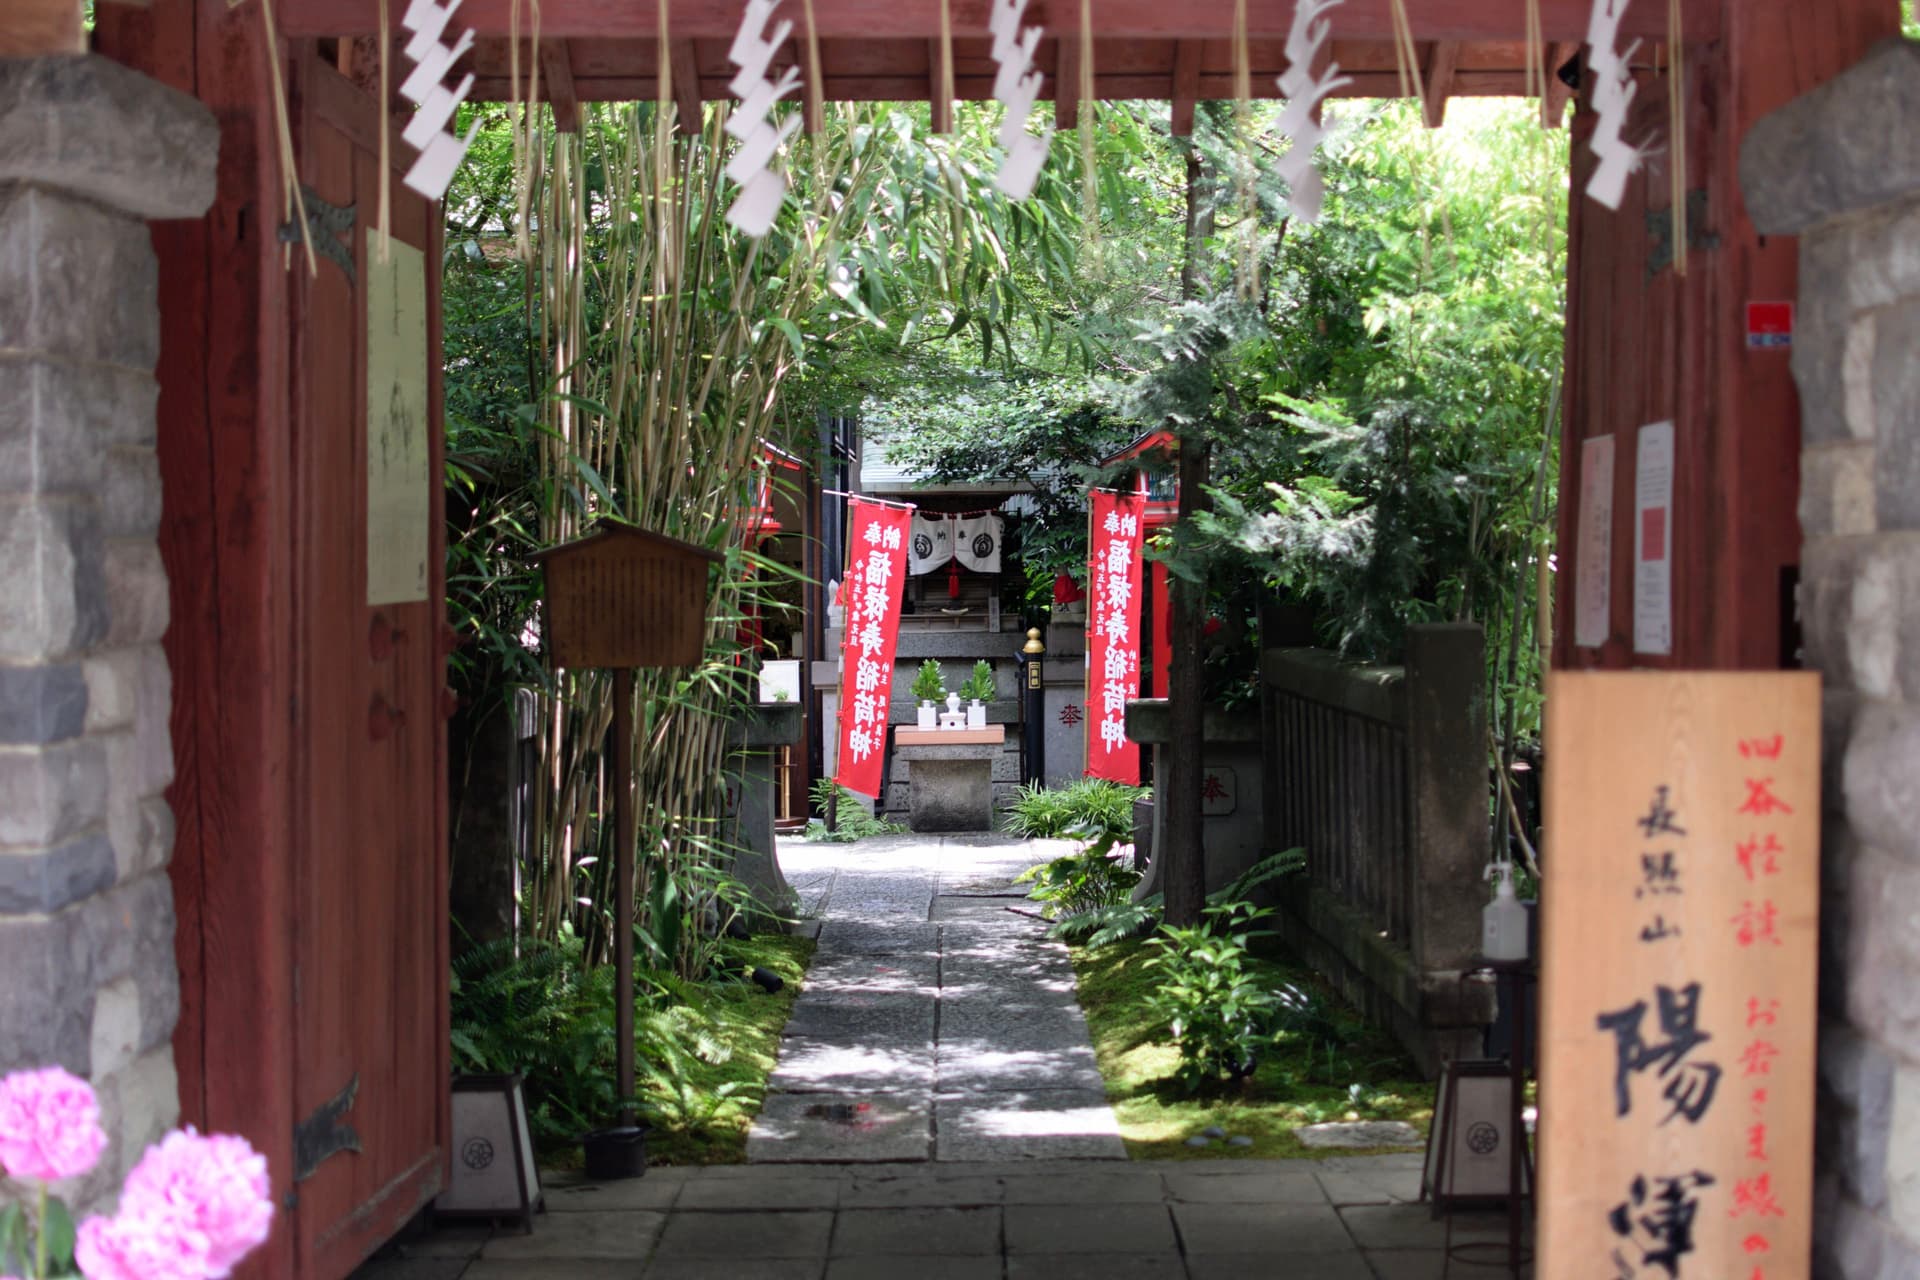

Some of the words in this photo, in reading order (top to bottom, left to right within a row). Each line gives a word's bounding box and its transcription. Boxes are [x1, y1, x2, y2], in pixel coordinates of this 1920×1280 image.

[1059, 703, 1083, 728] 奉
[1728, 732, 1794, 948] 四谷怪談
[1728, 996, 1787, 1280] お岩さま縁の
